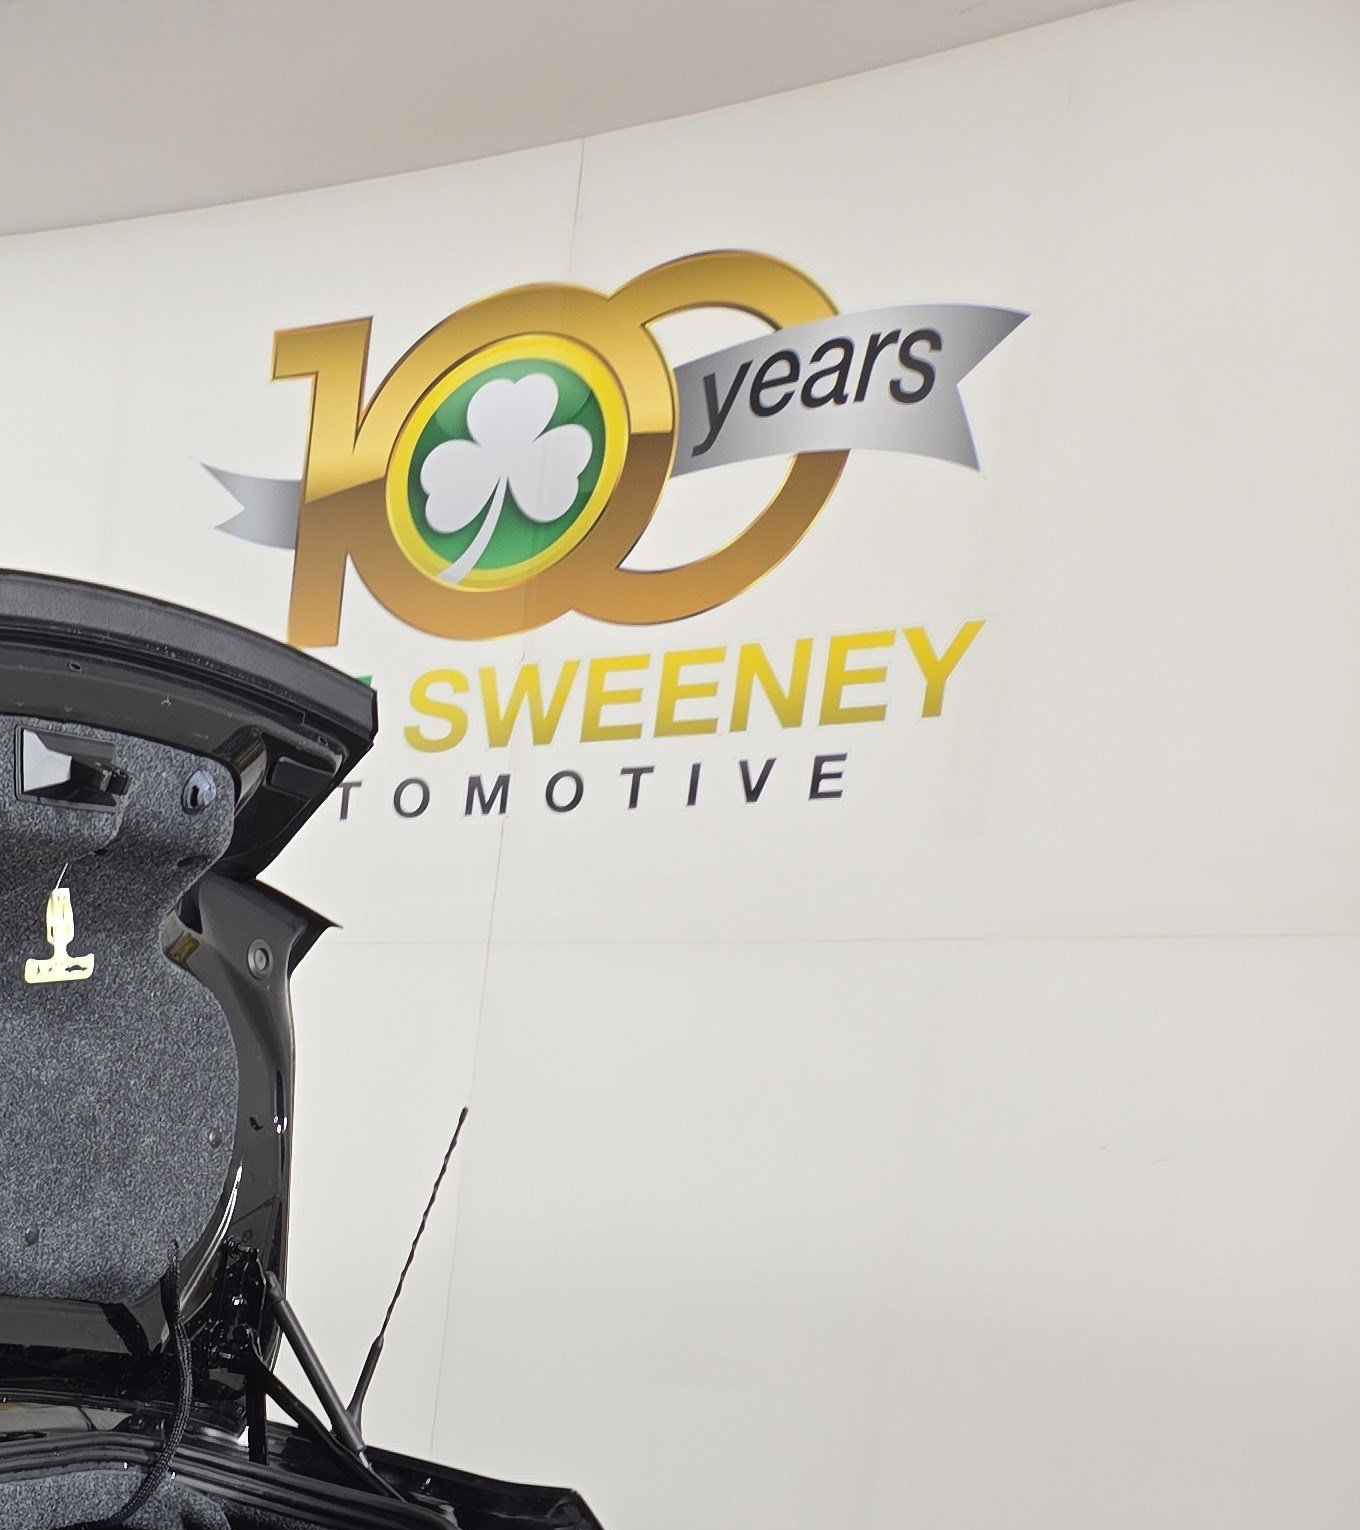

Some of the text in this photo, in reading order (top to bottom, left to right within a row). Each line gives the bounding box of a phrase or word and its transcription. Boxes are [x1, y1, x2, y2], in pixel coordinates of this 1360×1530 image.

[690, 325, 944, 458] years
[403, 619, 987, 753] SWEENEY
[337, 752, 850, 821] TOMOTIVE
